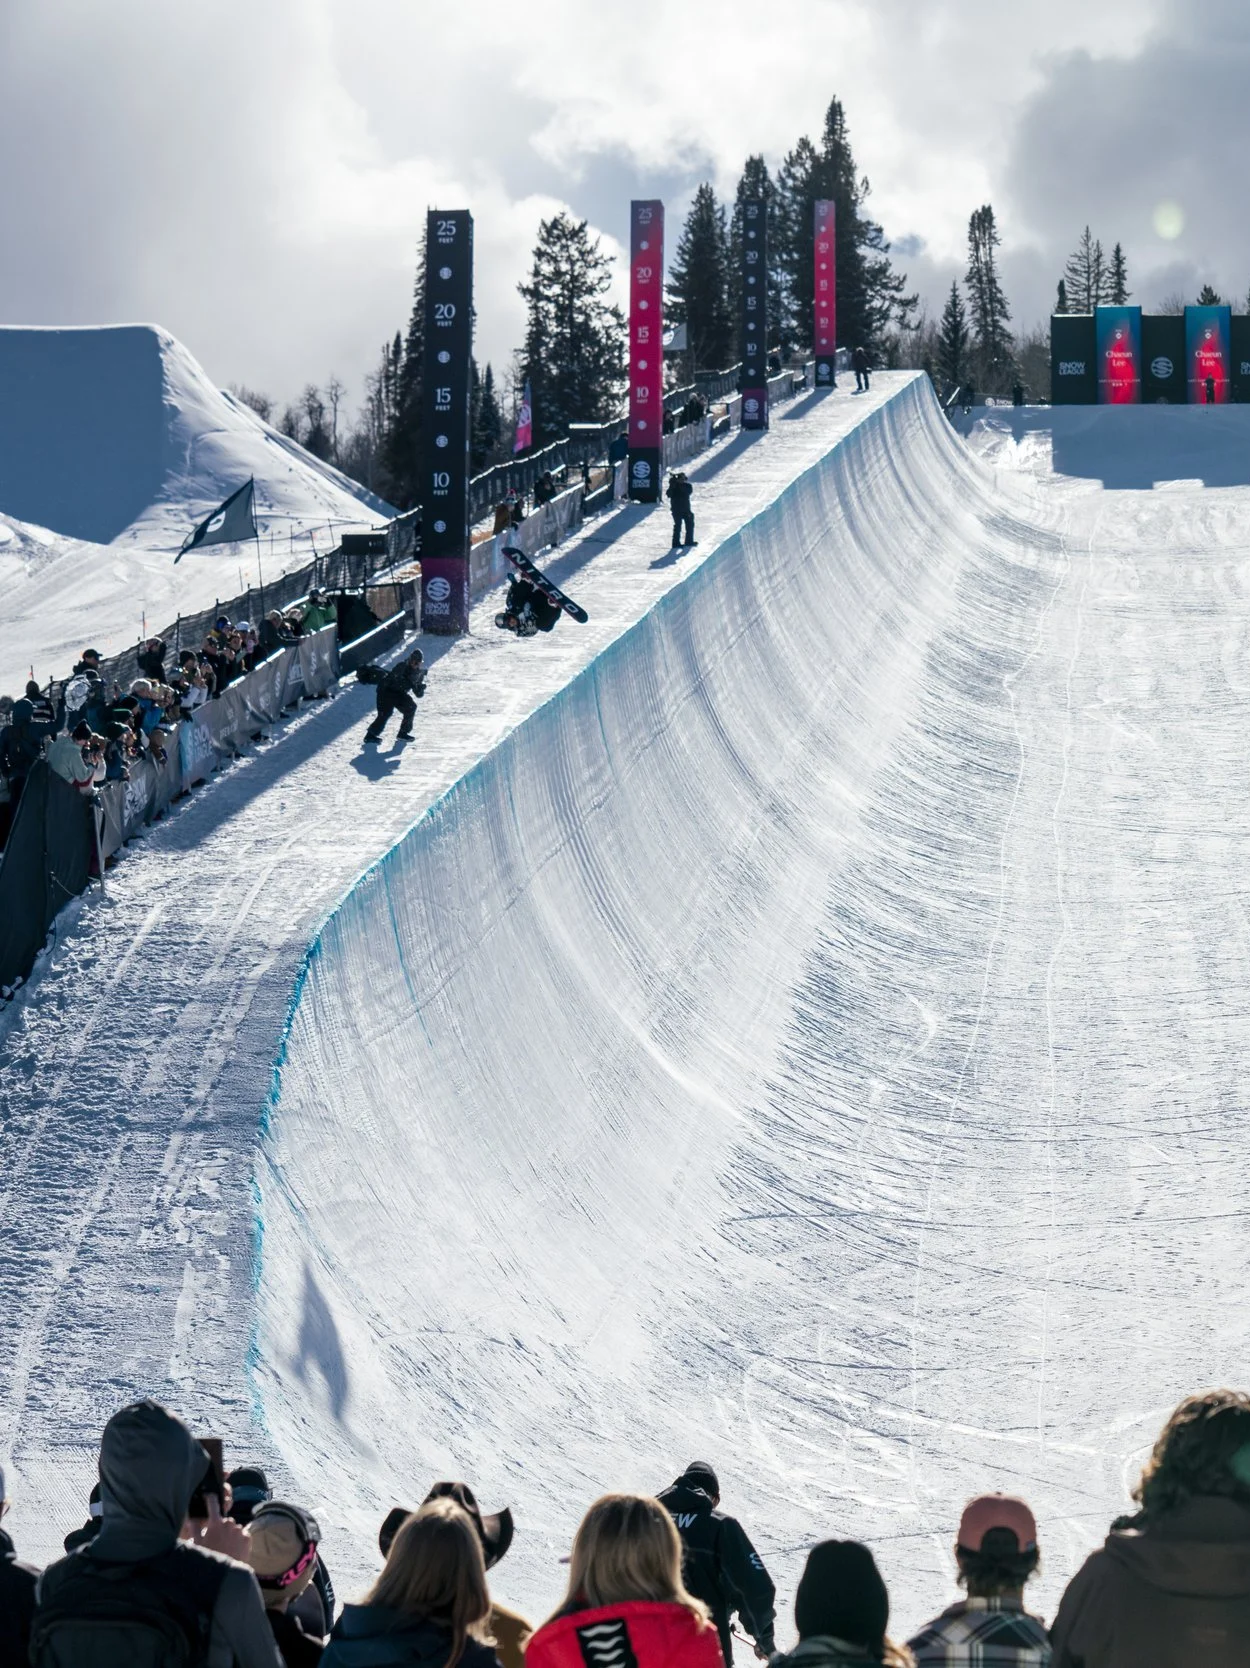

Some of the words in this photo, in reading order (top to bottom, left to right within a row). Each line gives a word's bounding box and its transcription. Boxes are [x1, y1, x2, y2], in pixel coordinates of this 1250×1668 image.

[639, 208, 652, 219] 25
[747, 206, 758, 216] 25
[437, 220, 456, 235] 25
[747, 251, 758, 260] 20
[637, 267, 652, 278] 20
[748, 297, 756, 307] 15
[435, 304, 455, 318] 20
[638, 326, 649, 338] 15
[1112, 359, 1126, 367] Lee
[1201, 359, 1216, 367] Lee
[437, 388, 451, 402] 15
[637, 387, 649, 398] 10
[434, 473, 449, 487] 10
[511, 552, 579, 614] NITRO
